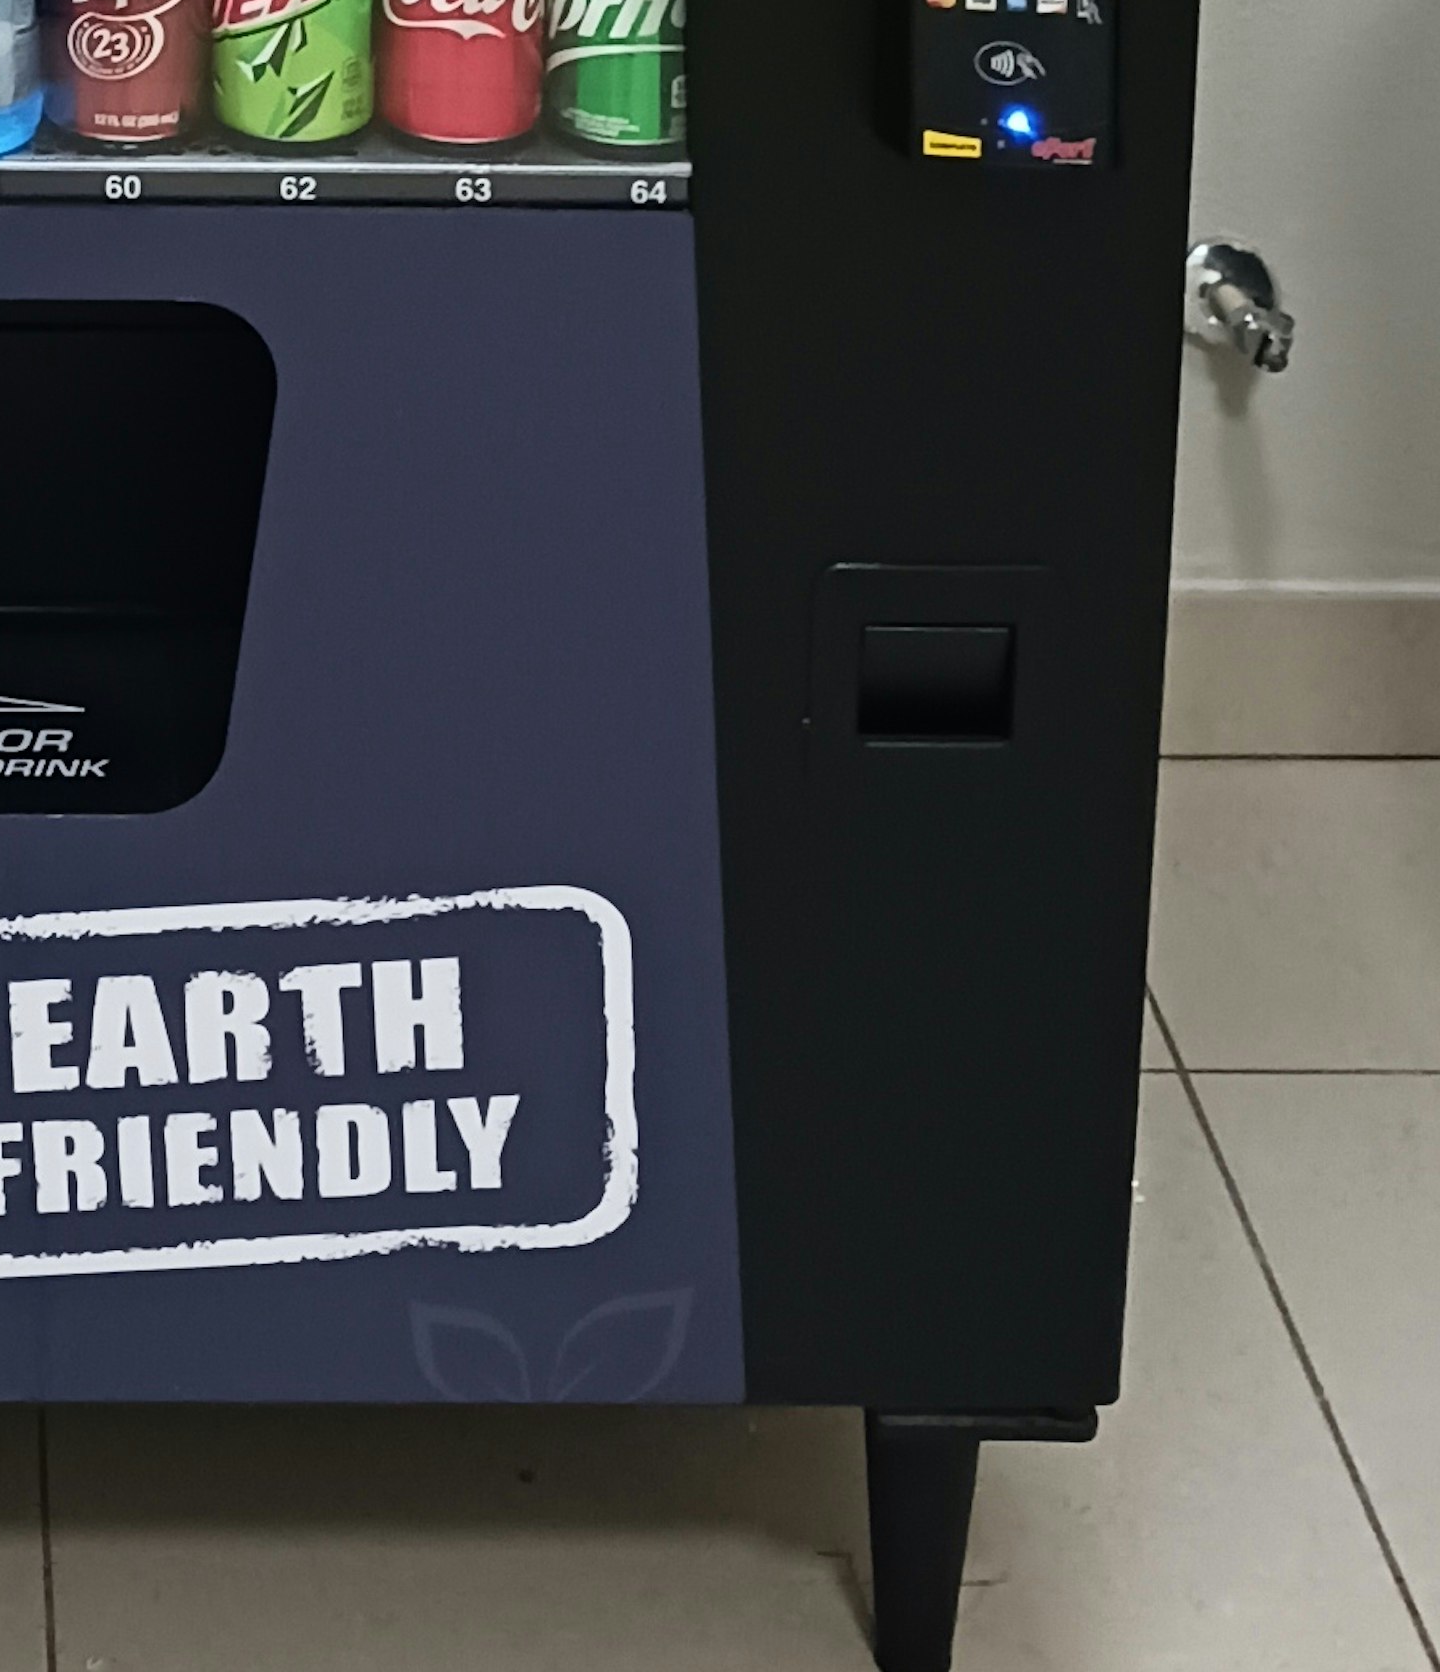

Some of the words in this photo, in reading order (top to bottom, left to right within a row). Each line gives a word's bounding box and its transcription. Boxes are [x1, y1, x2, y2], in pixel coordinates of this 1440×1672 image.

[92, 28, 130, 63] 23
[105, 175, 142, 200] 60
[280, 177, 318, 201] 62
[455, 179, 492, 202] 63
[630, 181, 668, 204] 64
[8, 956, 465, 1094] EARTH
